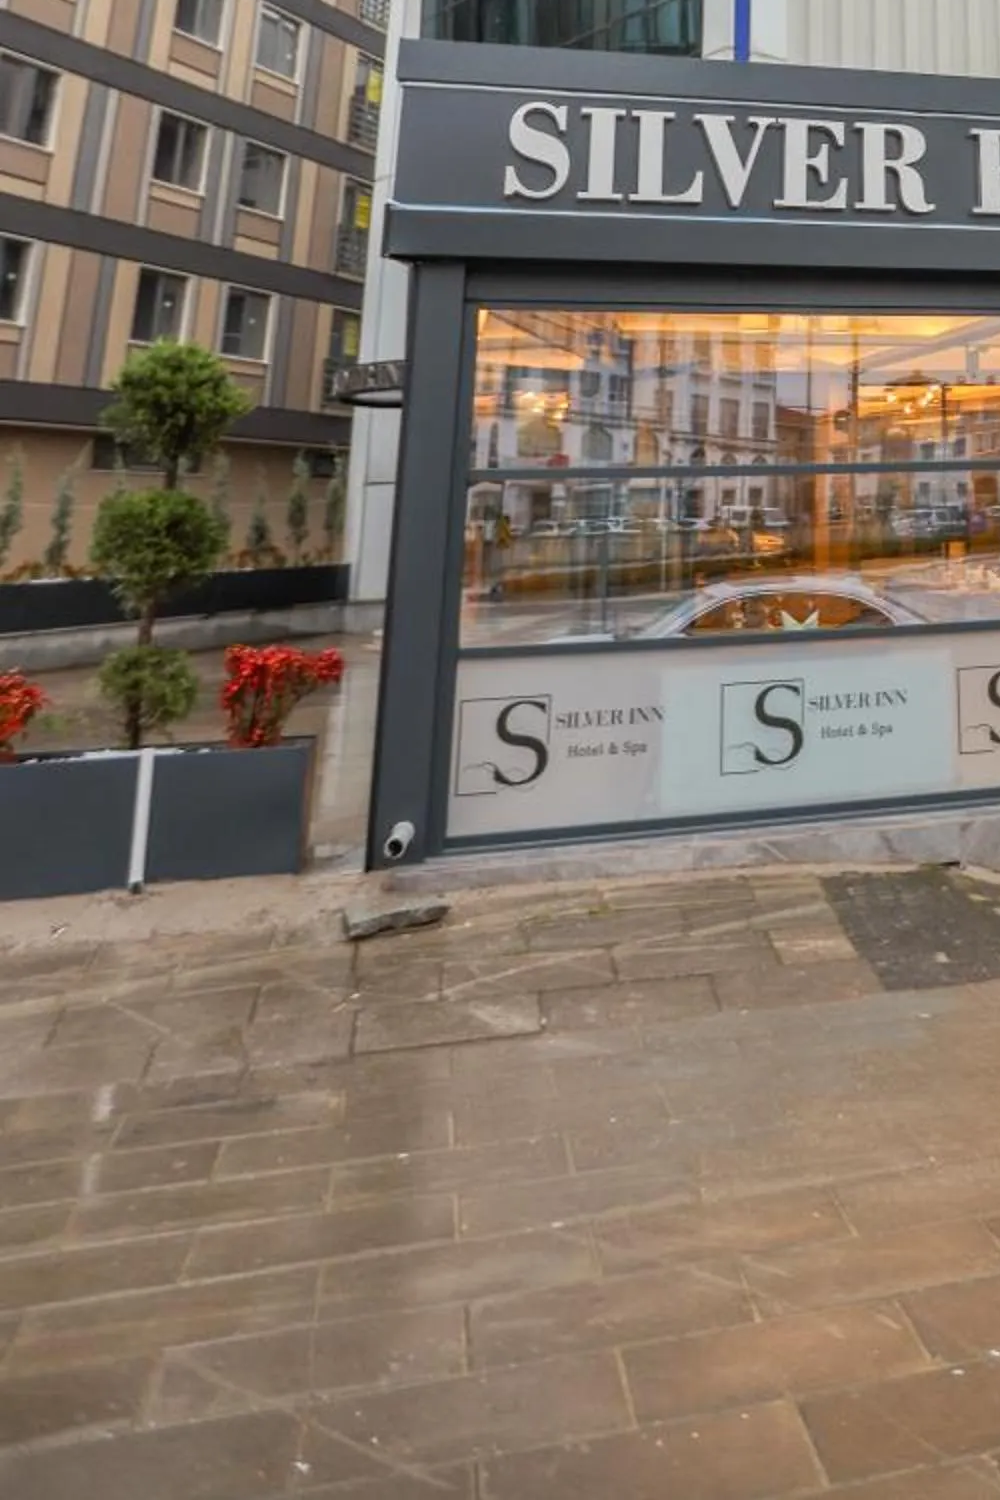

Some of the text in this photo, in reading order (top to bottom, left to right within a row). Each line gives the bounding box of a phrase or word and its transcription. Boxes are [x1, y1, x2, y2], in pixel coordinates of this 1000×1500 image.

[502, 100, 937, 214] SILVER
[807, 687, 908, 712] SILVER INN
[555, 704, 666, 730] SILVER INN
[567, 743, 604, 758] Hotel
